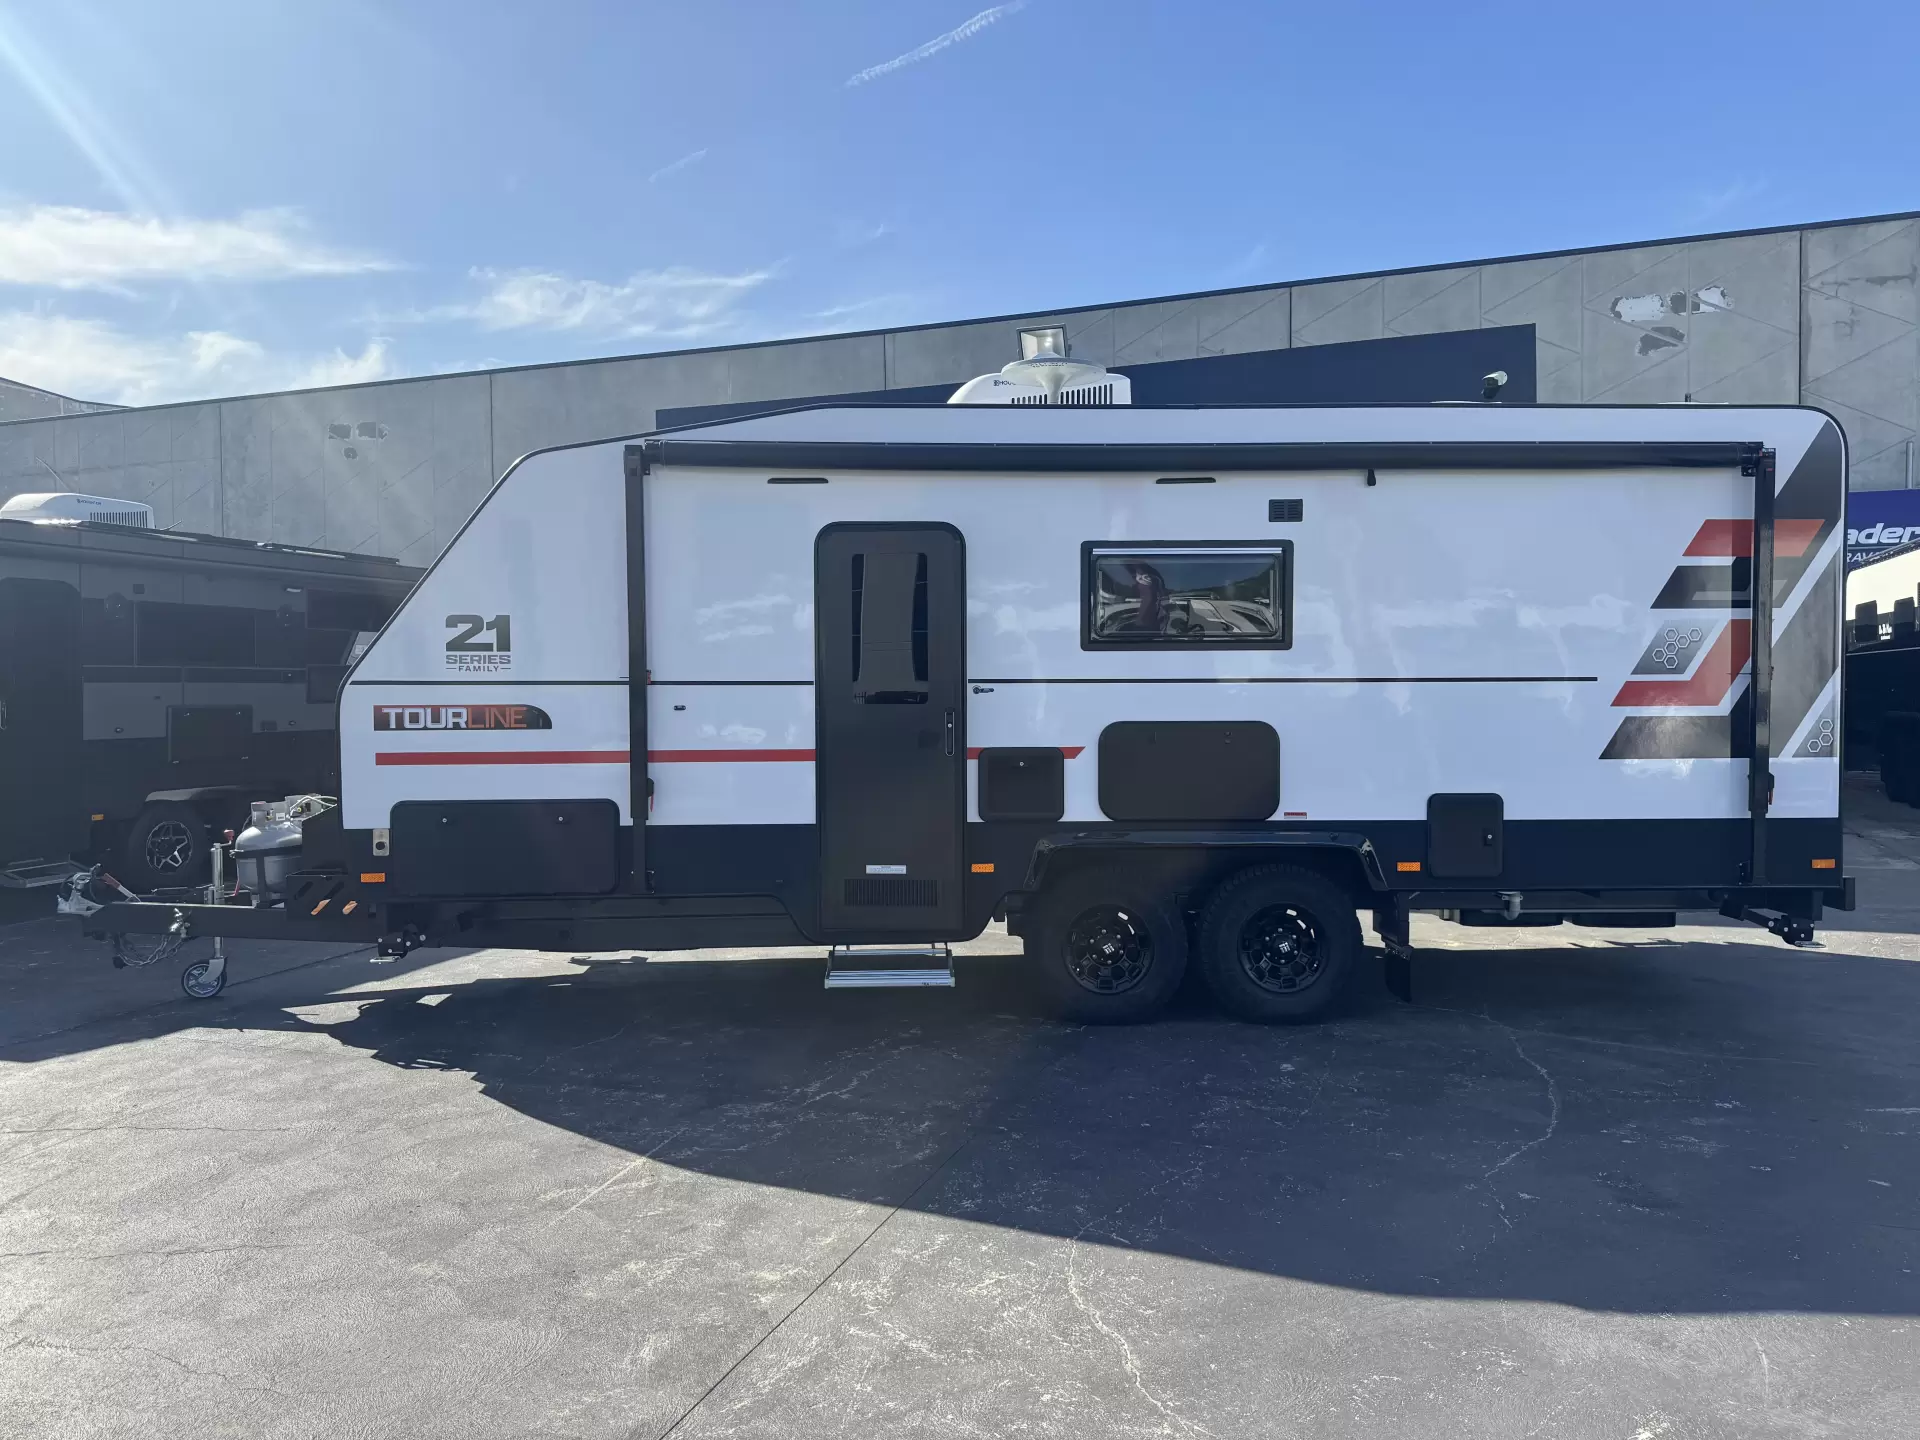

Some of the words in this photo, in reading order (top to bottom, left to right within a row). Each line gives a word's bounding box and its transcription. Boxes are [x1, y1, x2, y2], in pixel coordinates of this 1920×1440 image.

[1847, 551, 1878, 563] RAV
[445, 614, 511, 652] 21
[445, 654, 511, 665] SERIES
[381, 706, 528, 729] TOURLINE
